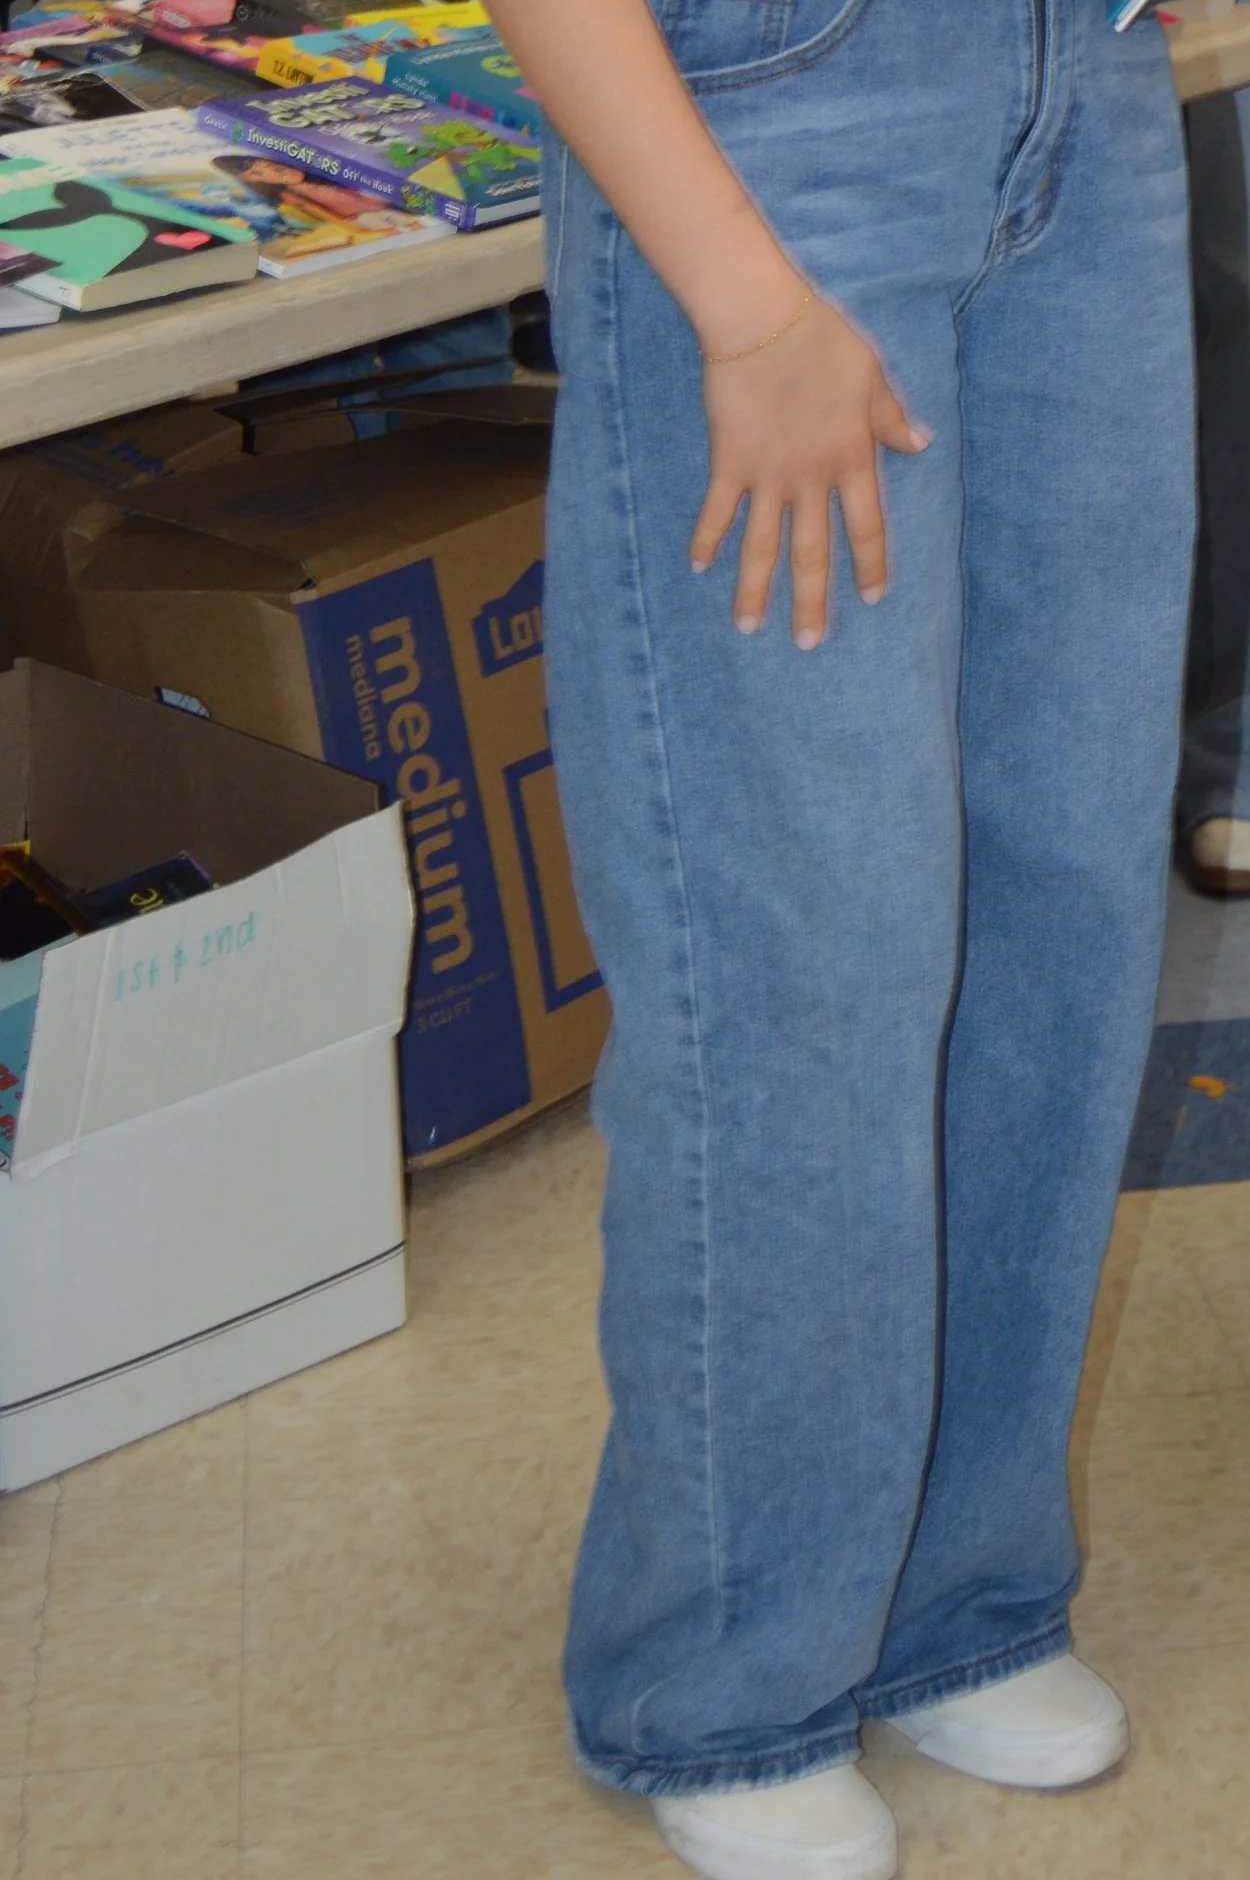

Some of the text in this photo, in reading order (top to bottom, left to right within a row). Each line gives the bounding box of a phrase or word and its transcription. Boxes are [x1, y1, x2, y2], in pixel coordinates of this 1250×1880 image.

[372, 178, 395, 196] Hook
[344, 633, 383, 763] mediana
[369, 615, 475, 977] medium
[199, 909, 257, 967] 2nd
